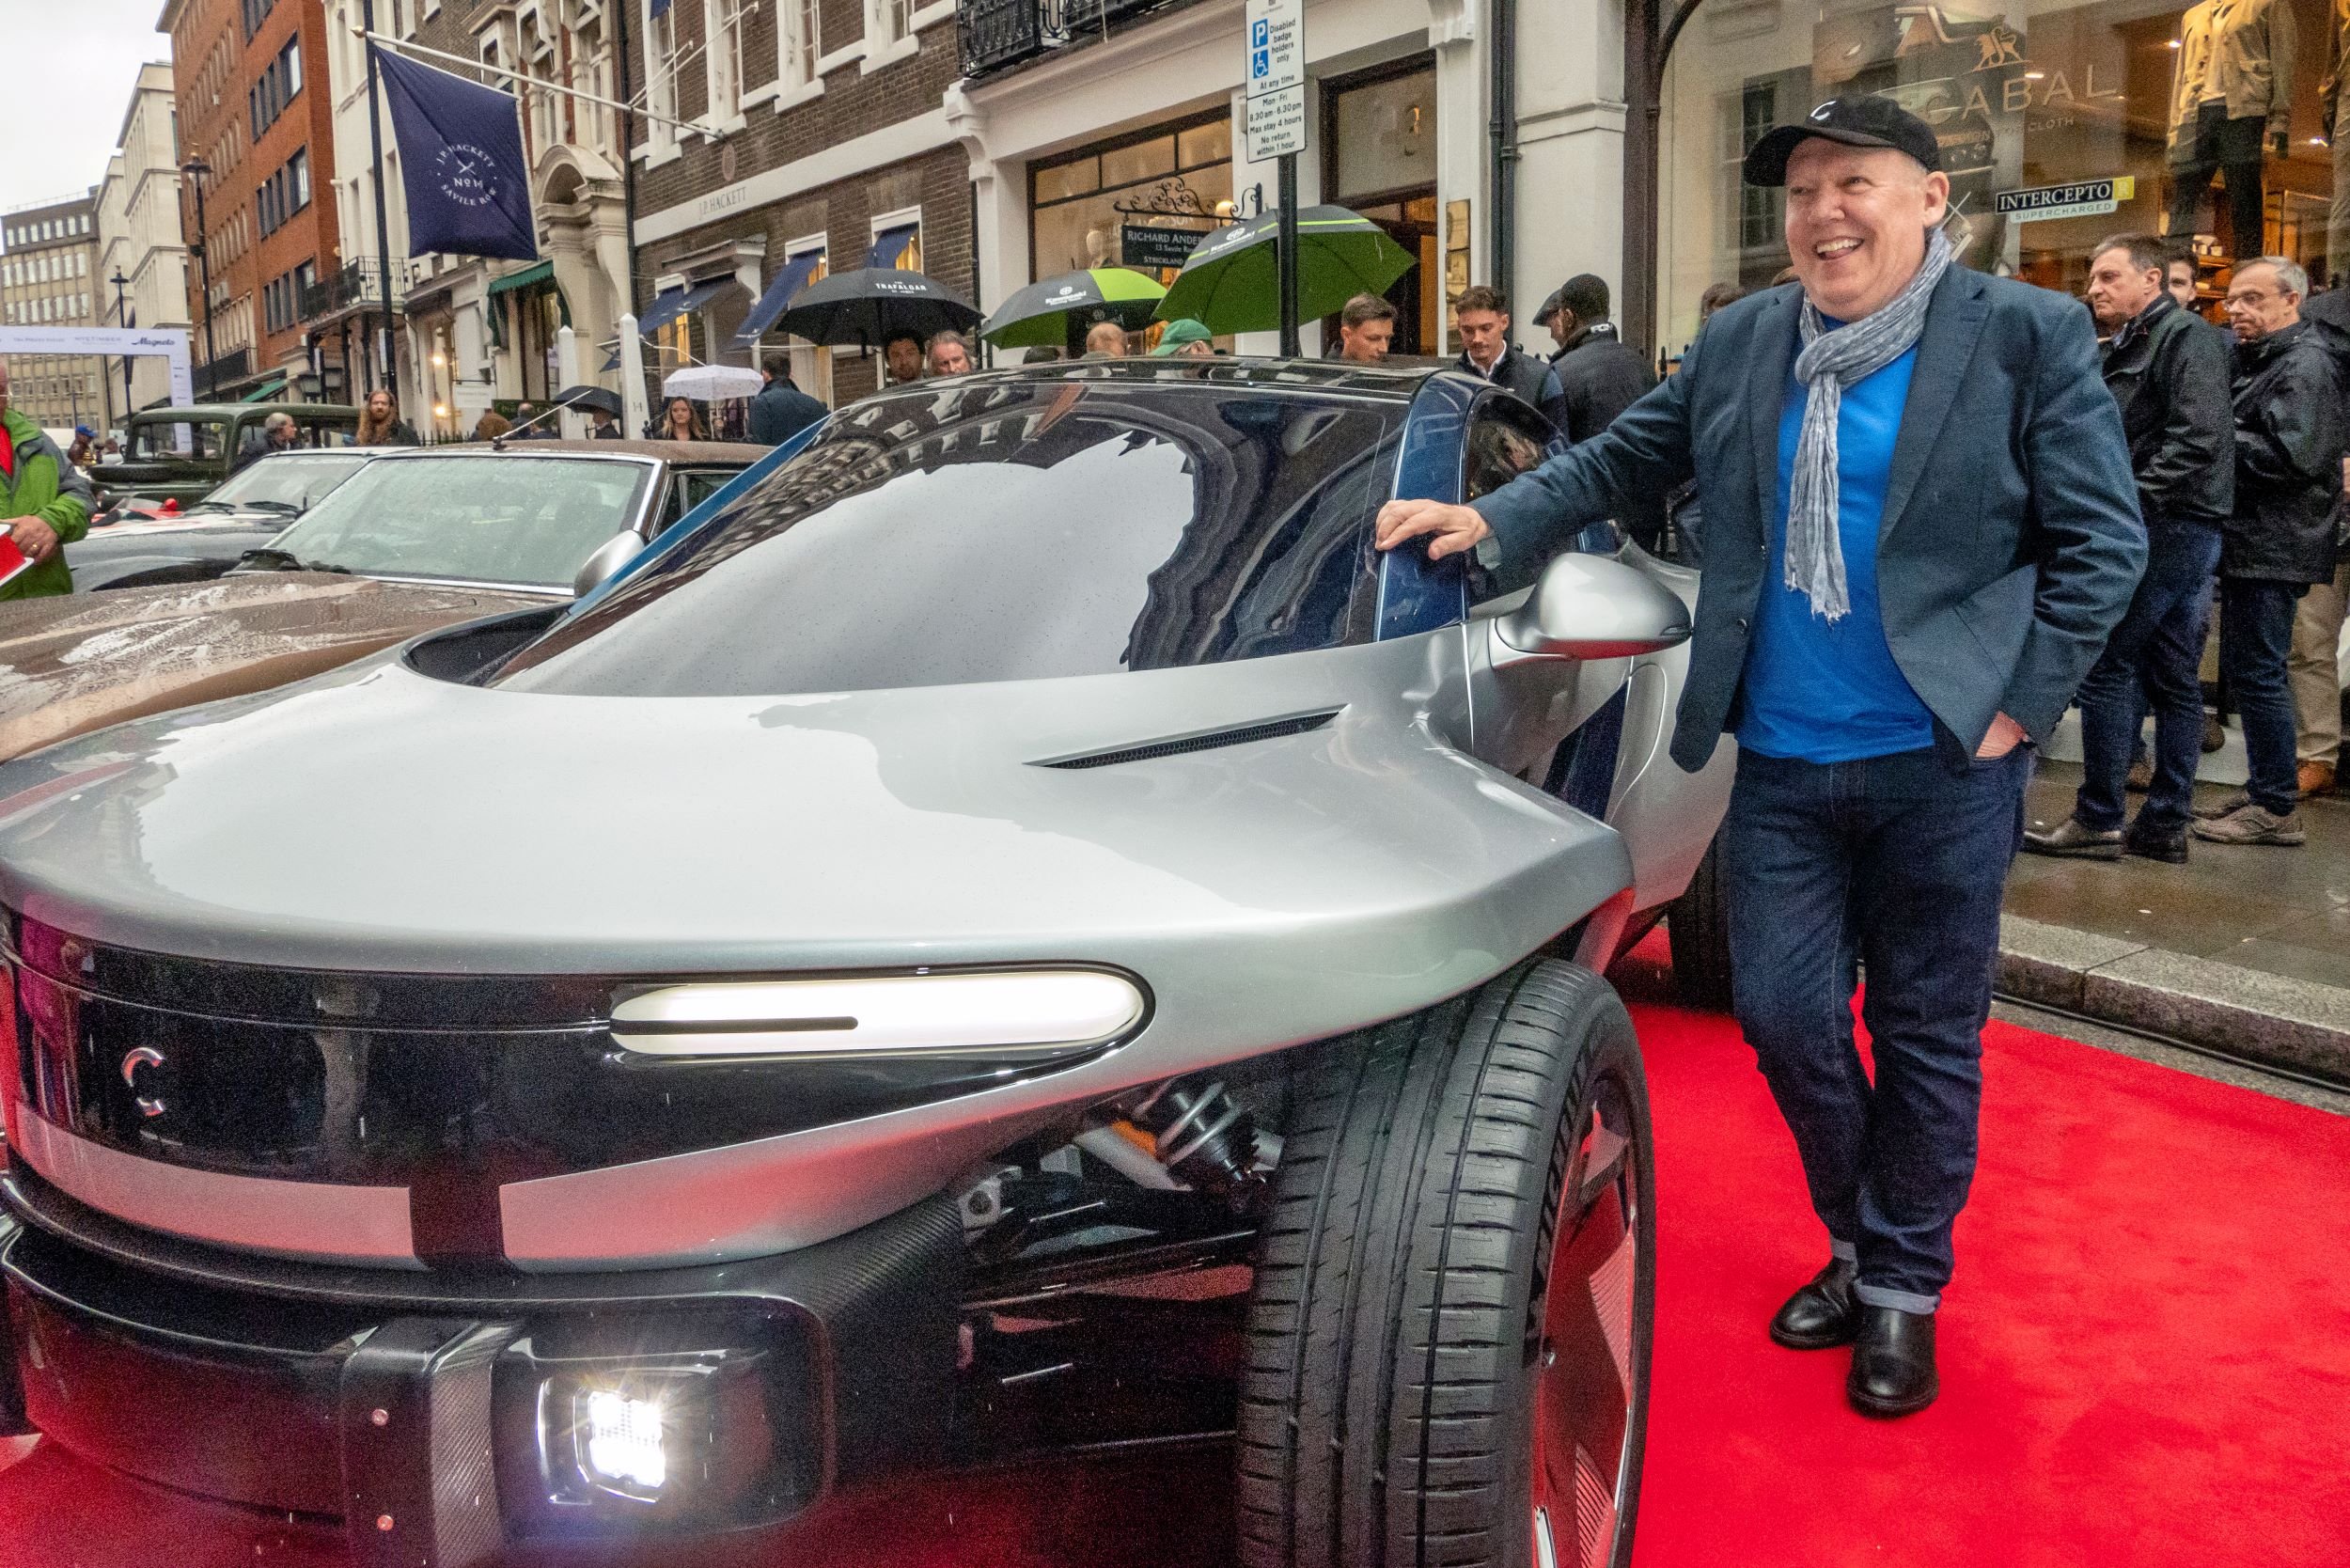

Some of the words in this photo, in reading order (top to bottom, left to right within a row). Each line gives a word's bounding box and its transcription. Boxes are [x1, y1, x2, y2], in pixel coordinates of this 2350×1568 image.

[1270, 18, 1295, 33] Disabled
[1274, 32, 1292, 43] badge
[1272, 42, 1293, 54] holders
[1277, 54, 1290, 63] only
[1261, 82, 1267, 90] At
[1269, 79, 1279, 88] any
[1281, 74, 1294, 84] time
[1249, 126, 1261, 134] Max
[1284, 116, 1302, 125] hours
[1272, 132, 1291, 142] return
[447, 144, 495, 167] HACKETT
[1257, 146, 1275, 156] within
[1281, 141, 1295, 149] hour
[441, 184, 477, 206] SAVILE
[478, 186, 496, 205] ROW
[710, 187, 746, 212] HACKETT
[2014, 202, 2112, 220] SUPERCHARGED
[1127, 230, 1170, 243] RICHARD
[1144, 256, 1183, 265] STRICKLAND
[875, 283, 927, 291] TRAFALGAR
[131, 337, 176, 347] Magneto
